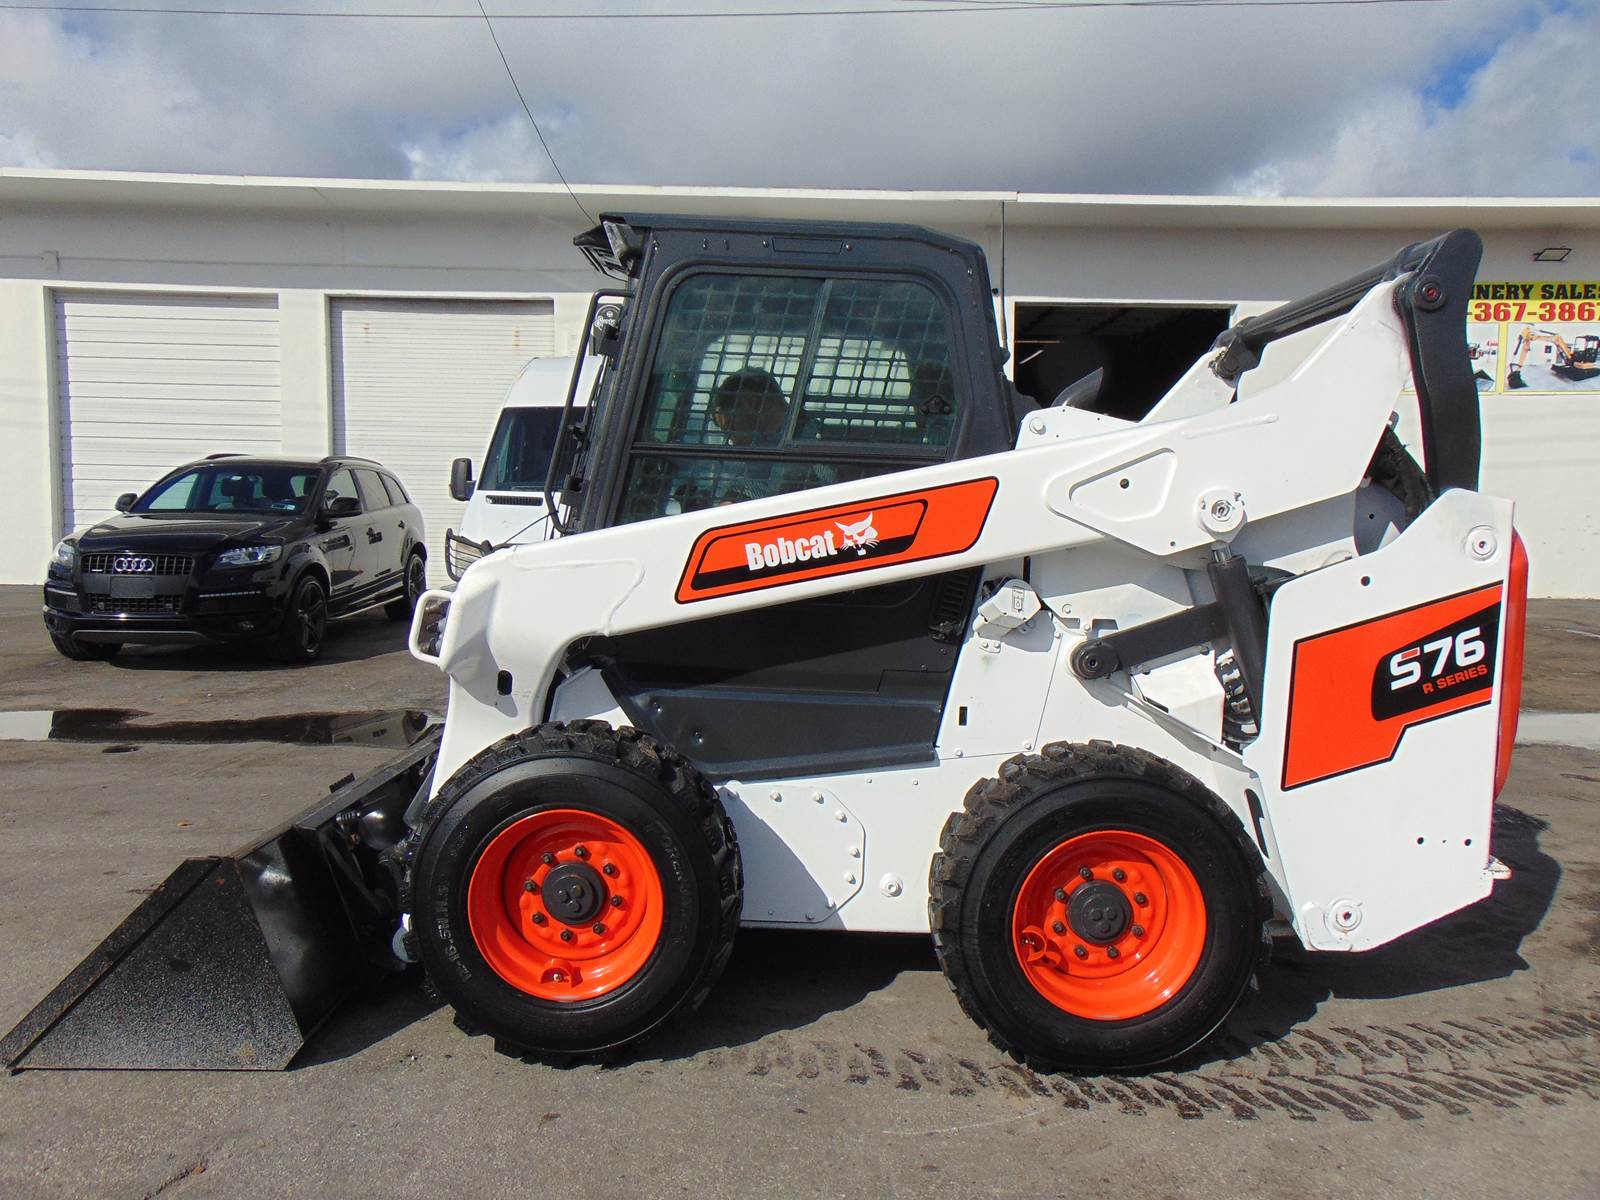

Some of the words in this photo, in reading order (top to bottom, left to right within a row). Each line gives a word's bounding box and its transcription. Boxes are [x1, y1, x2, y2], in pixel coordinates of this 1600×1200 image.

[1541, 284, 1600, 300] SALE
[745, 530, 837, 571] Bobcat
[1389, 626, 1485, 691] S76
[1422, 682, 1434, 695] R
[1437, 665, 1487, 689] SERIES
